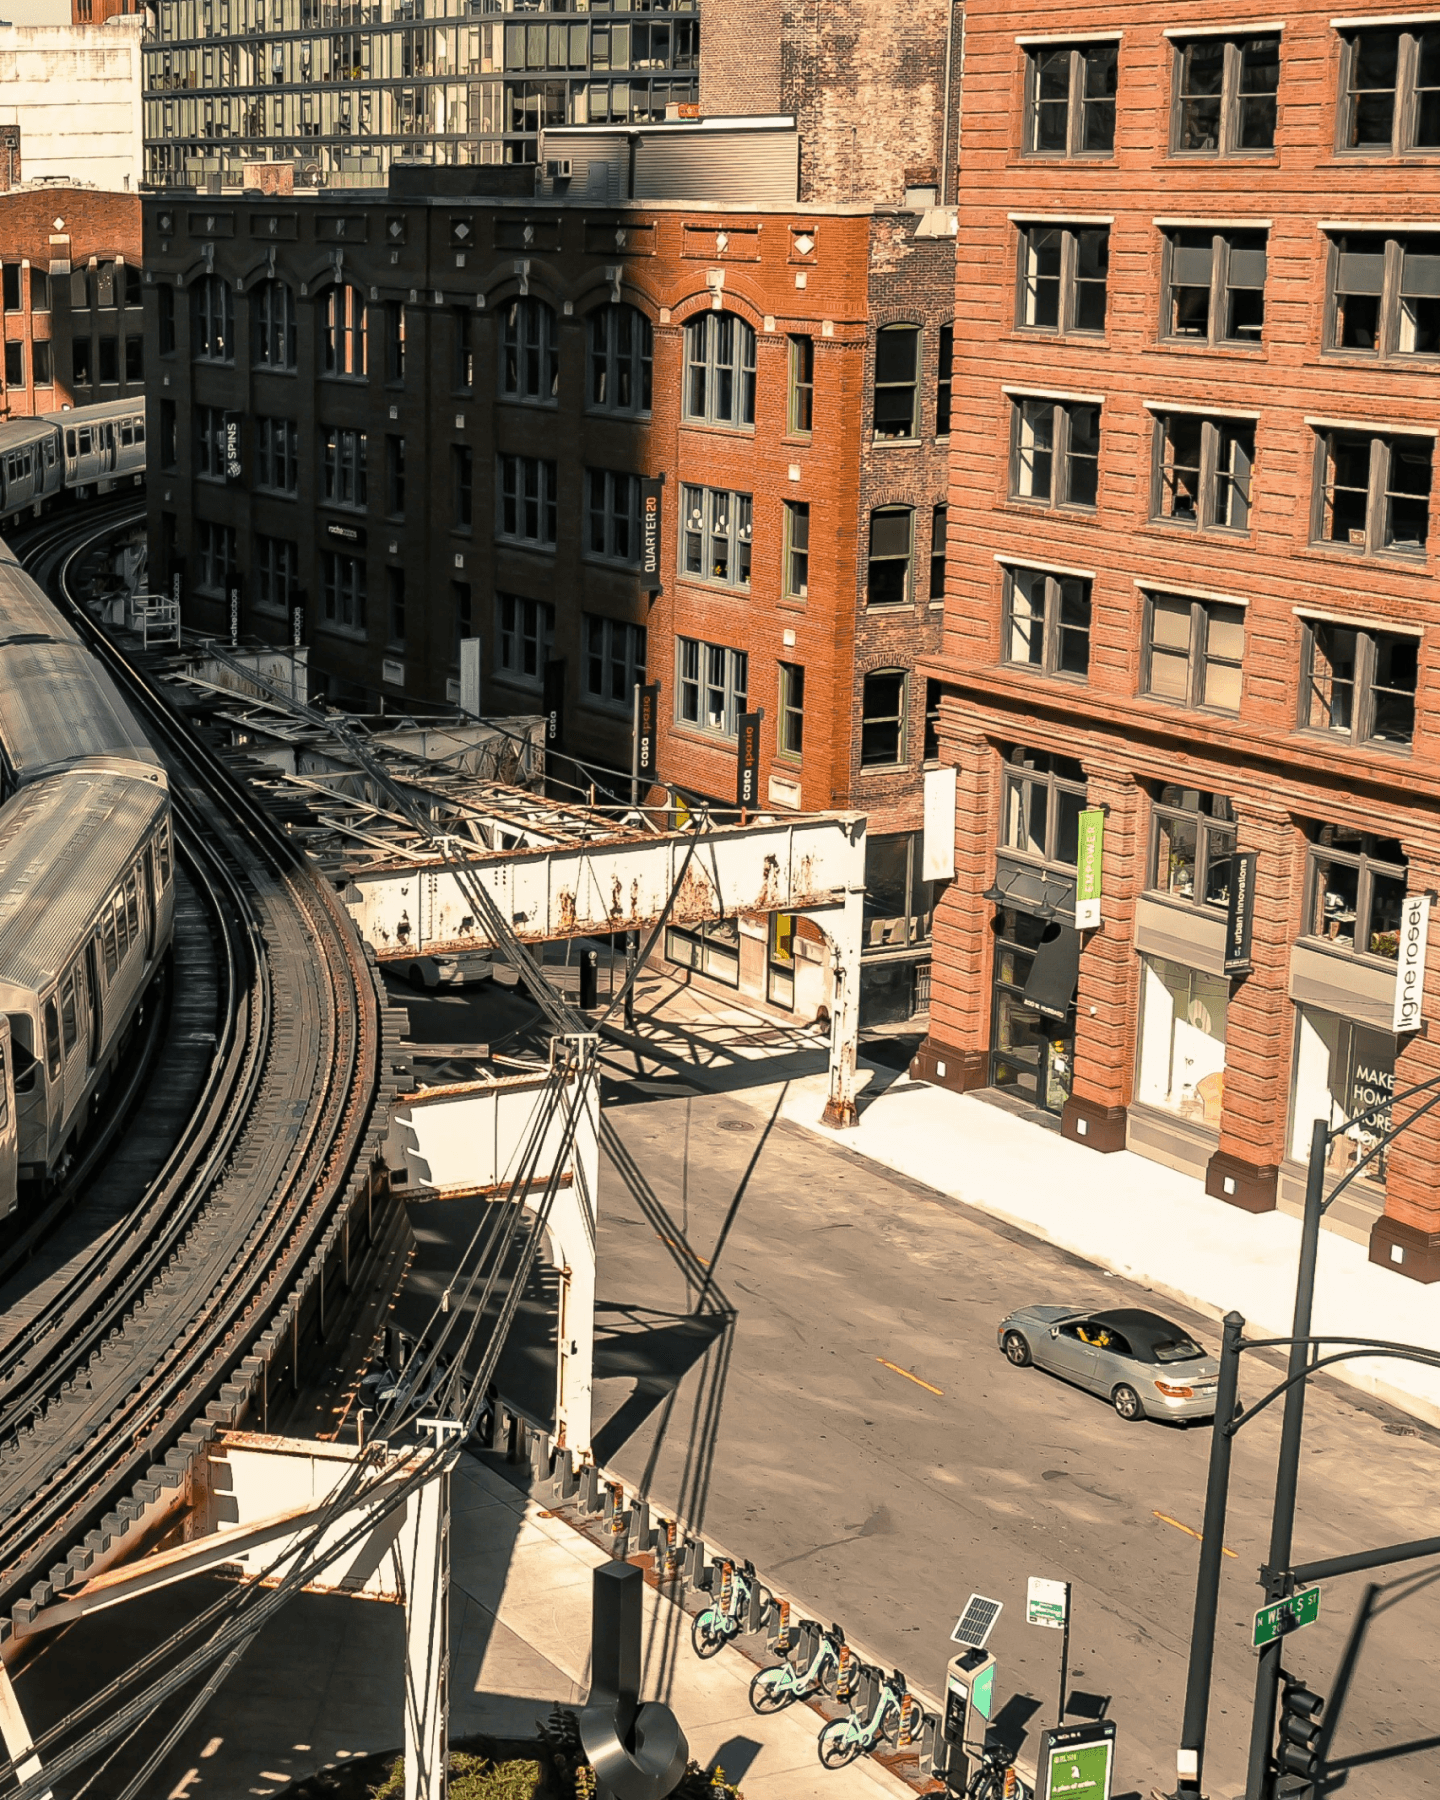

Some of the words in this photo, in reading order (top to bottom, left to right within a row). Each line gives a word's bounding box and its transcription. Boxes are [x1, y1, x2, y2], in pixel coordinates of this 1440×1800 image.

[227, 422, 237, 459] SPINS
[549, 710, 557, 739] casa
[640, 737, 649, 768] casa
[743, 769, 752, 801] casa
[1084, 826, 1096, 894] EMPOWER
[1233, 916, 1244, 945] urban
[1406, 901, 1423, 966] roset
[1397, 971, 1419, 1028] ligne
[1356, 1064, 1395, 1090] MAKE
[1257, 1616, 1263, 1627] N
[1268, 1598, 1304, 1625] WELLS
[1307, 1593, 1317, 1605] ST
